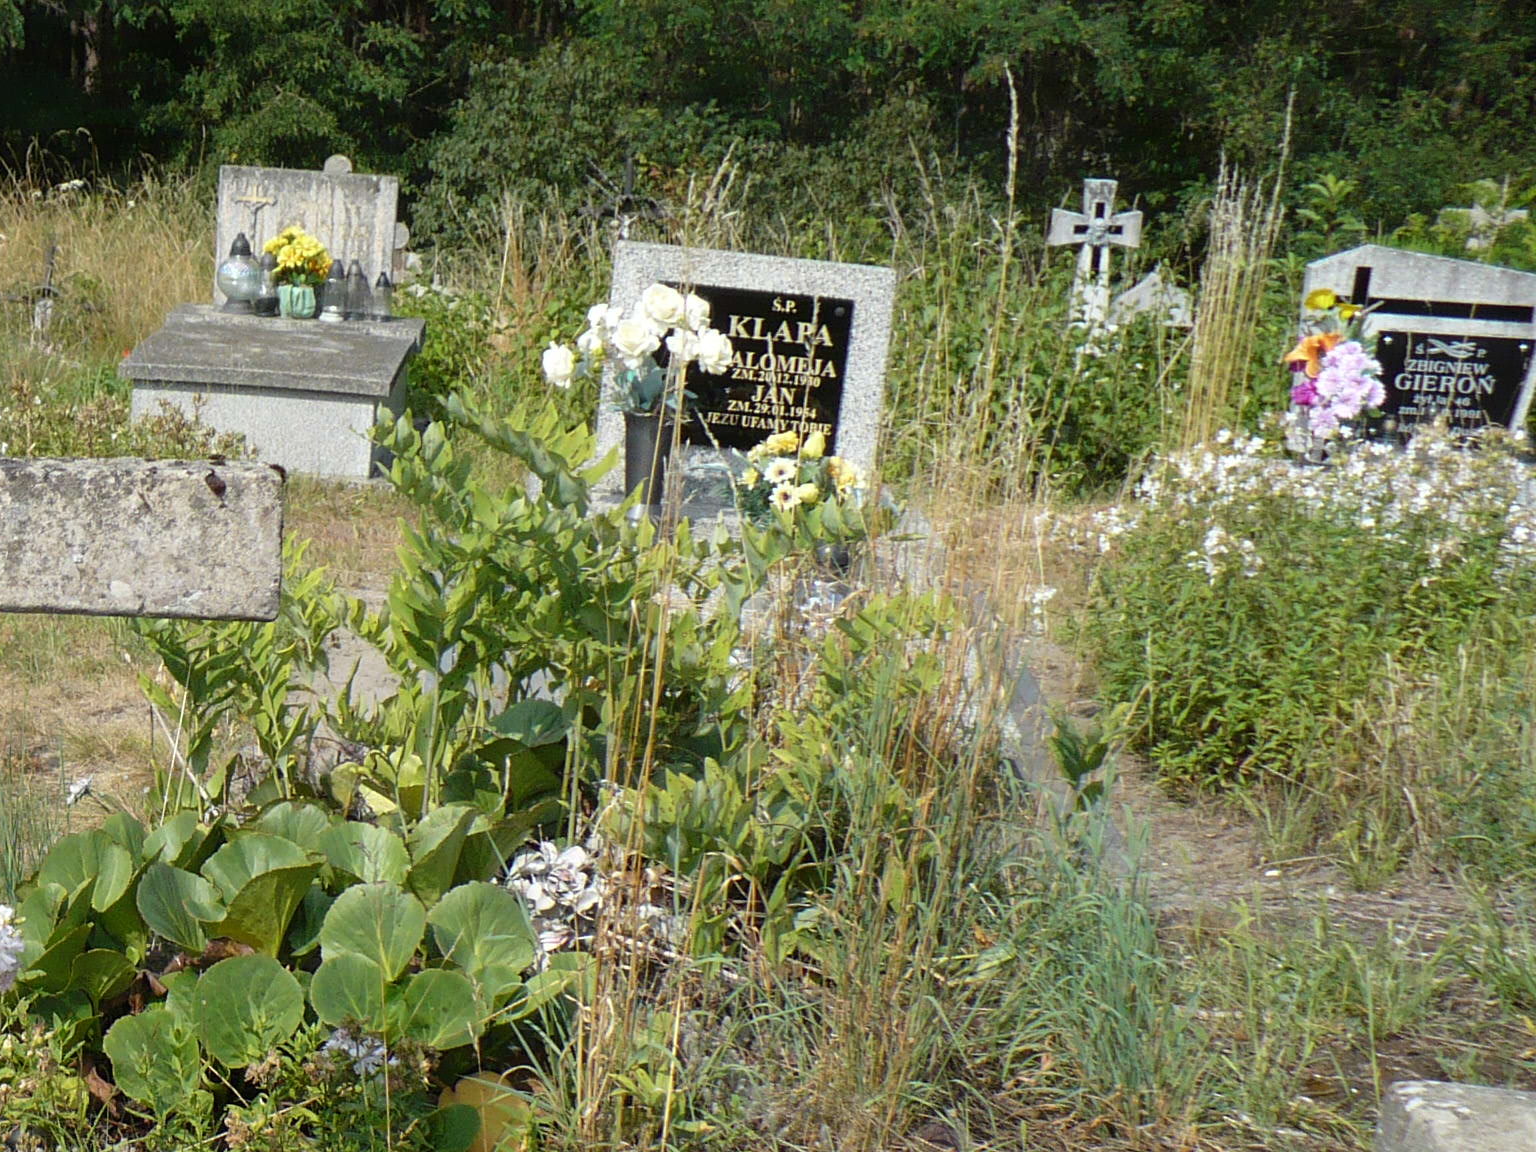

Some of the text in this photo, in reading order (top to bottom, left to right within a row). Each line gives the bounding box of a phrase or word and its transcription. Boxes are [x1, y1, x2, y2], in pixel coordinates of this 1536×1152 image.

[730, 350, 837, 379] ALOMEJA
[1406, 359, 1490, 376] ZBIGNIEW
[751, 384, 797, 406] JAN
[1394, 374, 1496, 395] GIEROŃ
[706, 411, 832, 437] JEZU UFAMY TOBIE
